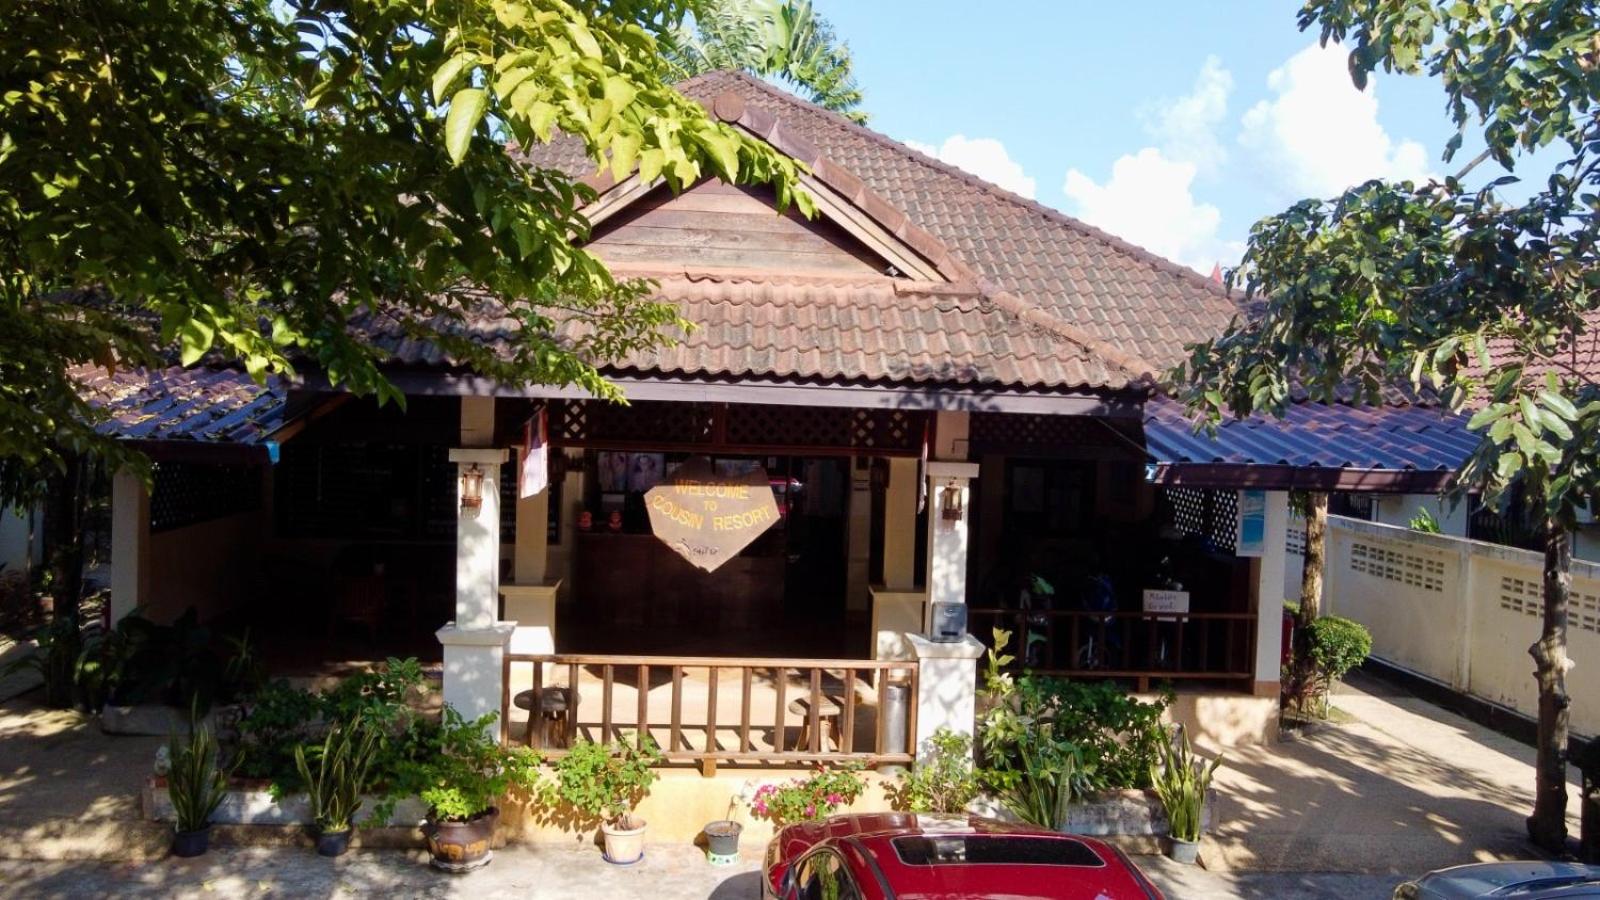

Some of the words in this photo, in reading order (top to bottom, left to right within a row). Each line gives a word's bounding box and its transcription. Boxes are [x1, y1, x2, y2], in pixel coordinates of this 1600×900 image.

[675, 480, 750, 499] WELCOME
[653, 495, 704, 529] COUSIN
[713, 505, 771, 530] RESORT
[704, 500, 717, 512] TO
